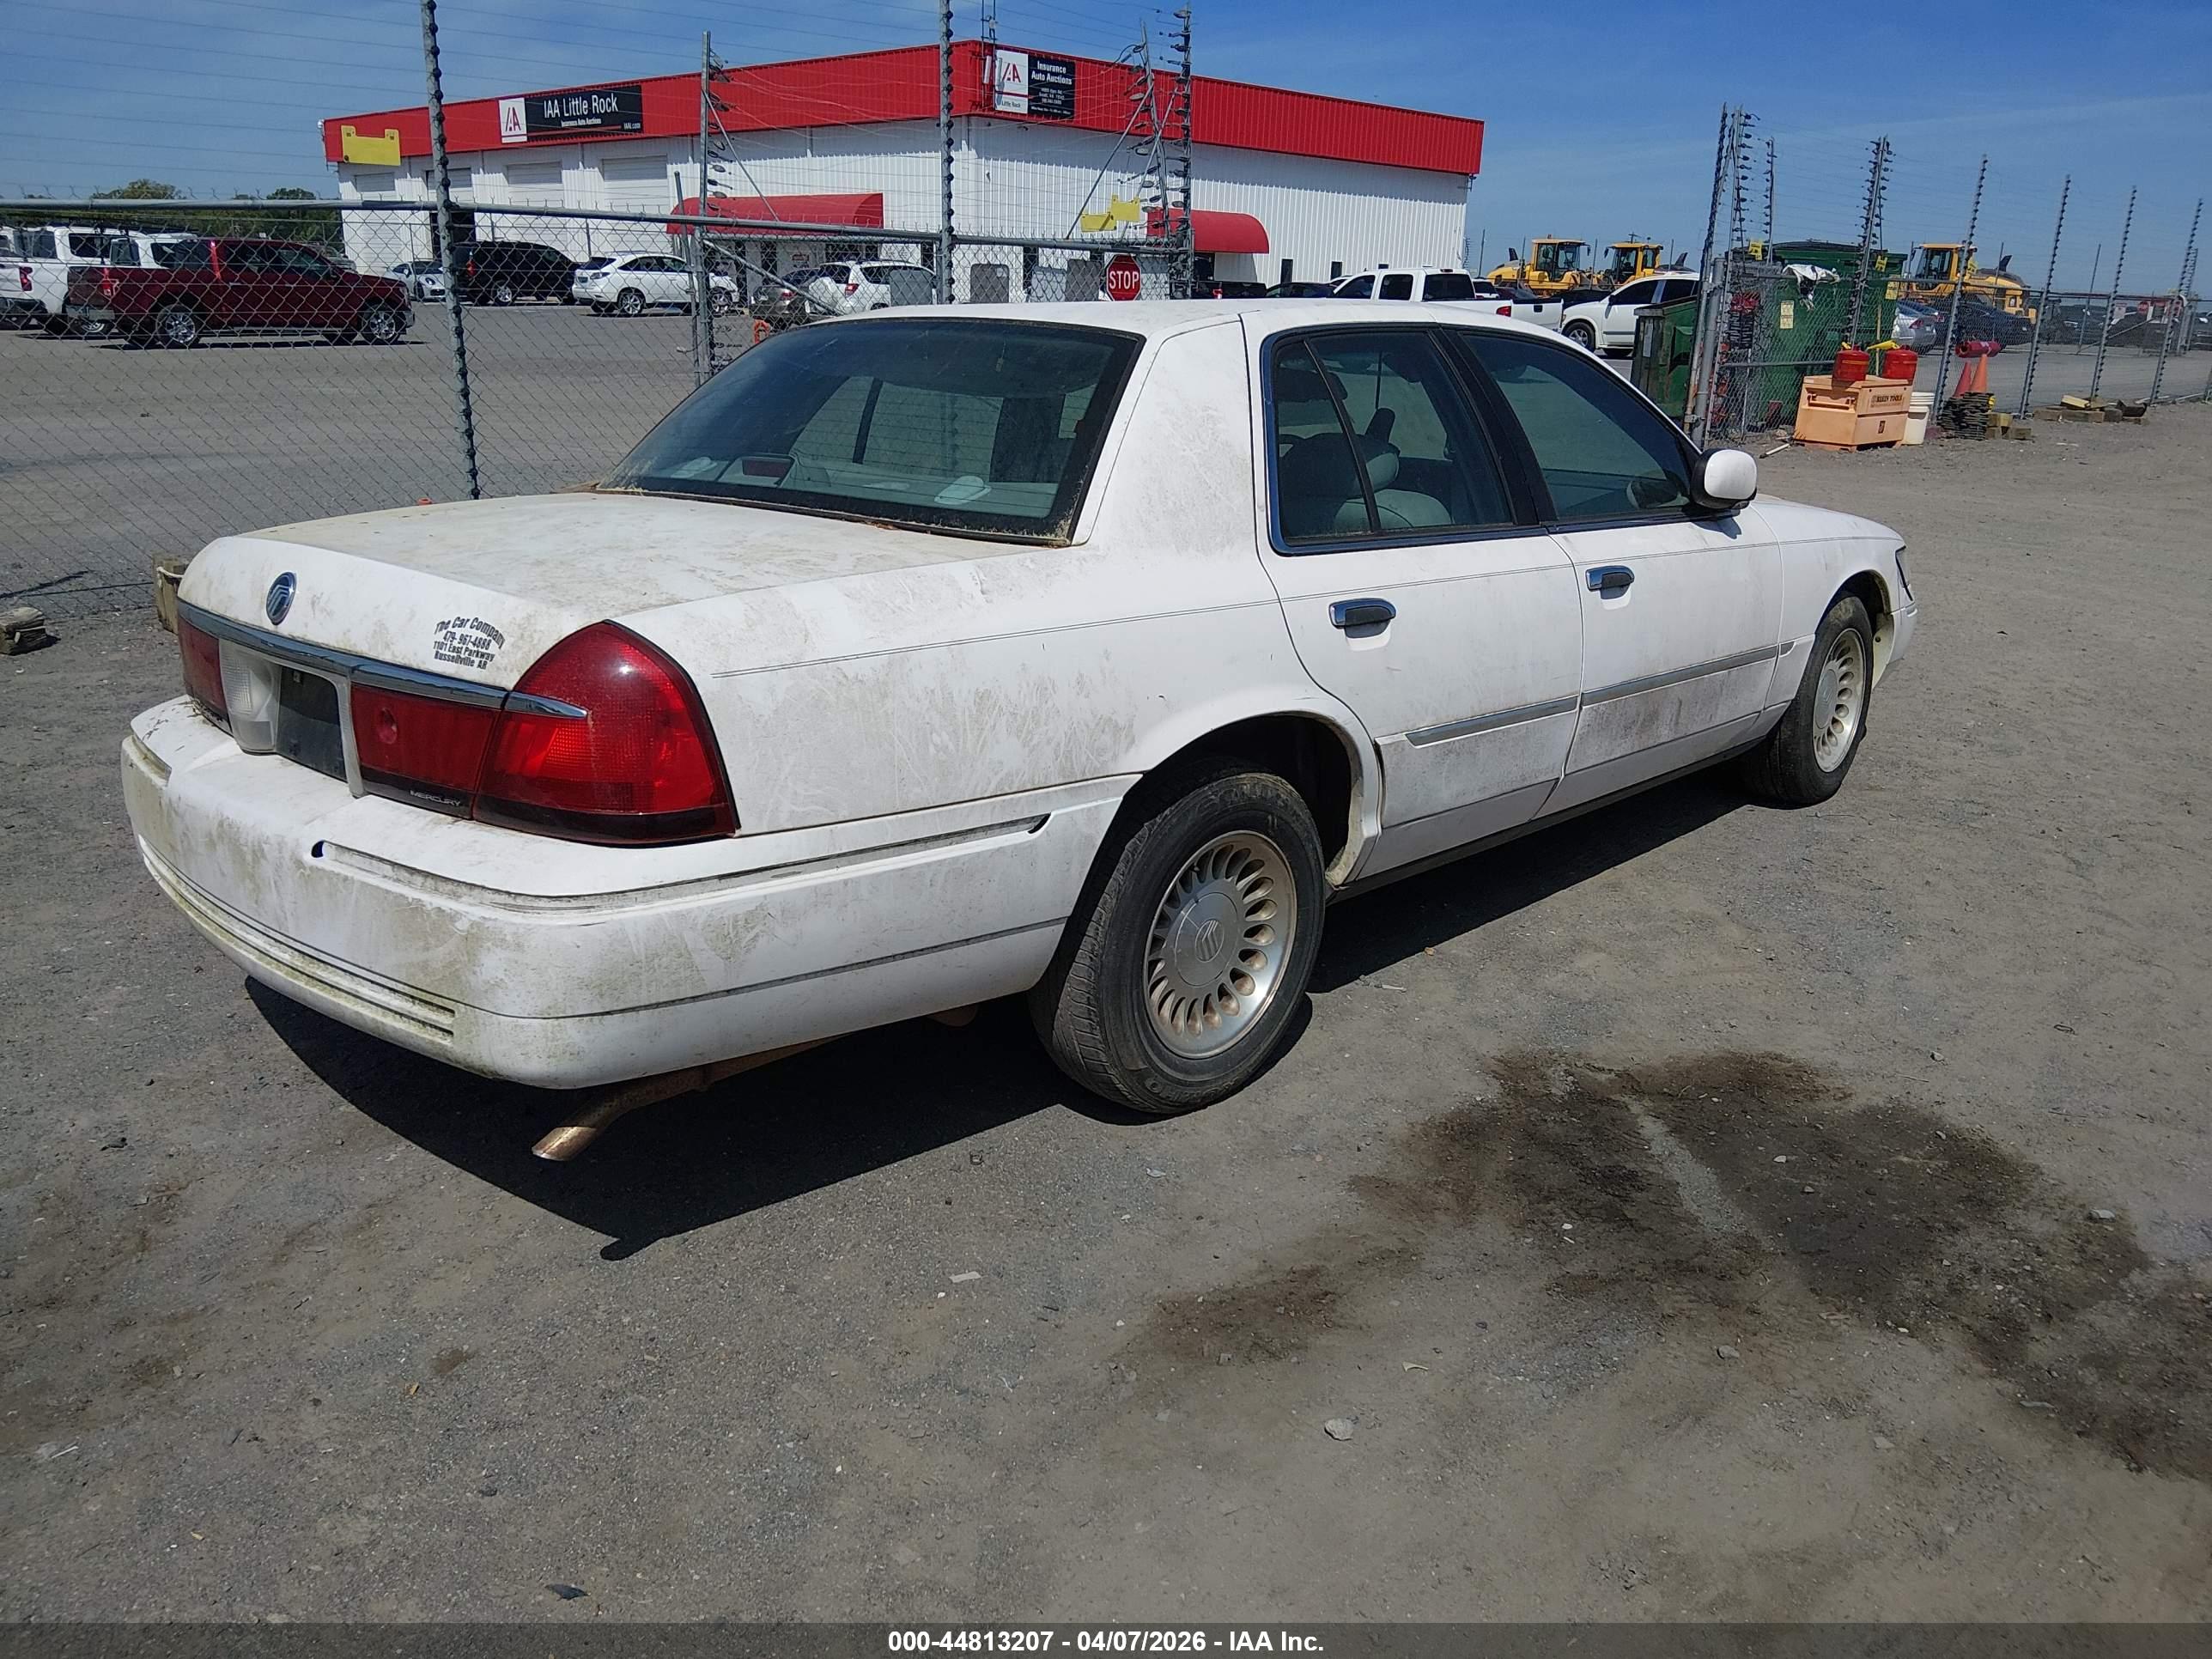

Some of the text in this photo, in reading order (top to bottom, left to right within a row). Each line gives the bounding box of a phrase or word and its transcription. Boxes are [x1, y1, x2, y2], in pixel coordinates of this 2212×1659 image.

[1037, 61, 1066, 74] Insurance
[1031, 70, 1073, 85] Auto Auctions
[544, 93, 618, 118] IAA Little Rock
[1109, 270, 1139, 289] STOP
[434, 617, 506, 650] The Car Company
[434, 650, 488, 670] Russellville AR
[448, 642, 464, 655] East
[464, 647, 495, 662] Parkway
[410, 790, 461, 806] MERCURY
